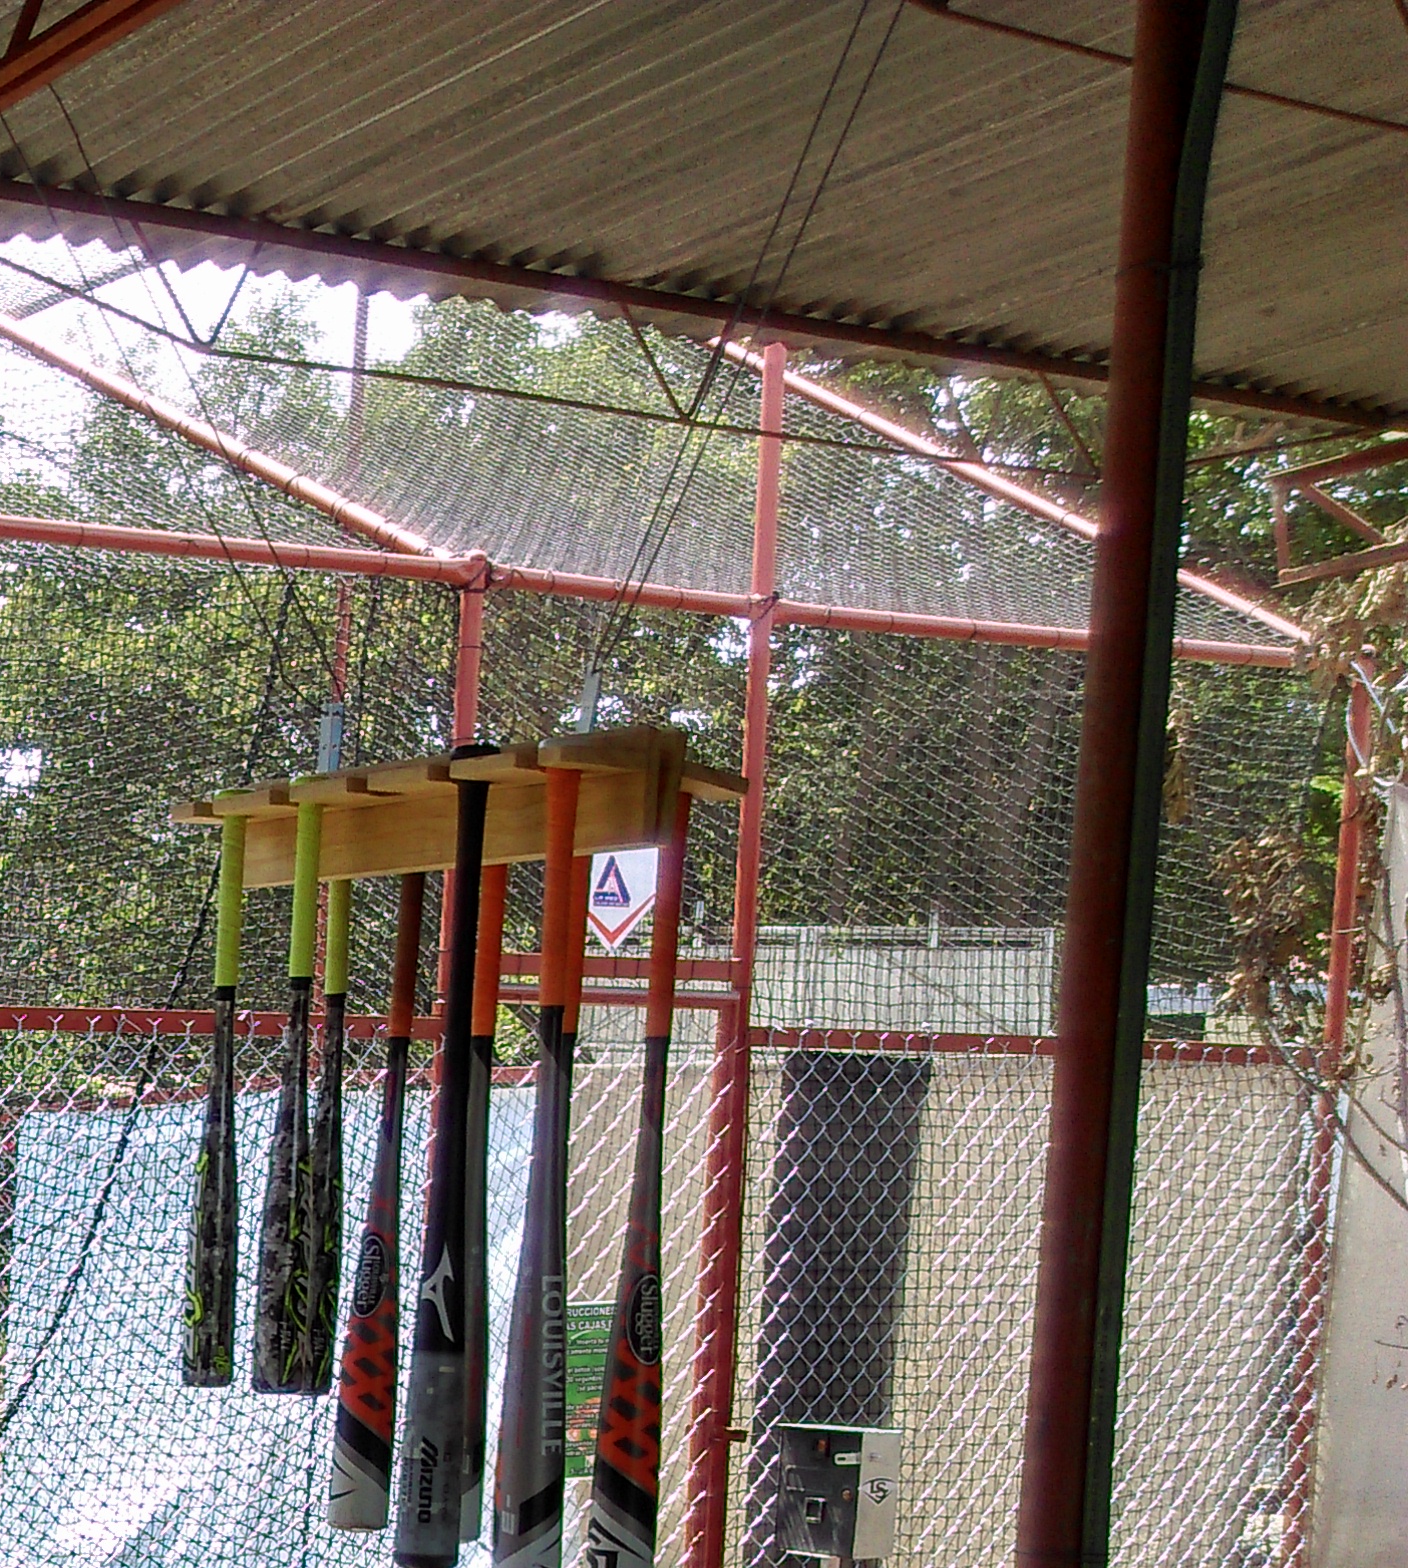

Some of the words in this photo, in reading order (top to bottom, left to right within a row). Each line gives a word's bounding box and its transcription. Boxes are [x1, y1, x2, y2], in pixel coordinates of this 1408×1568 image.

[357, 1244, 380, 1308] Slugger
[578, 1320, 606, 1330] CAJAS
[635, 1284, 658, 1354] Slugger
[540, 1274, 564, 1456] LOUISVILLE
[417, 1436, 439, 1524] MIZUNO
[870, 1481, 888, 1500] LS
